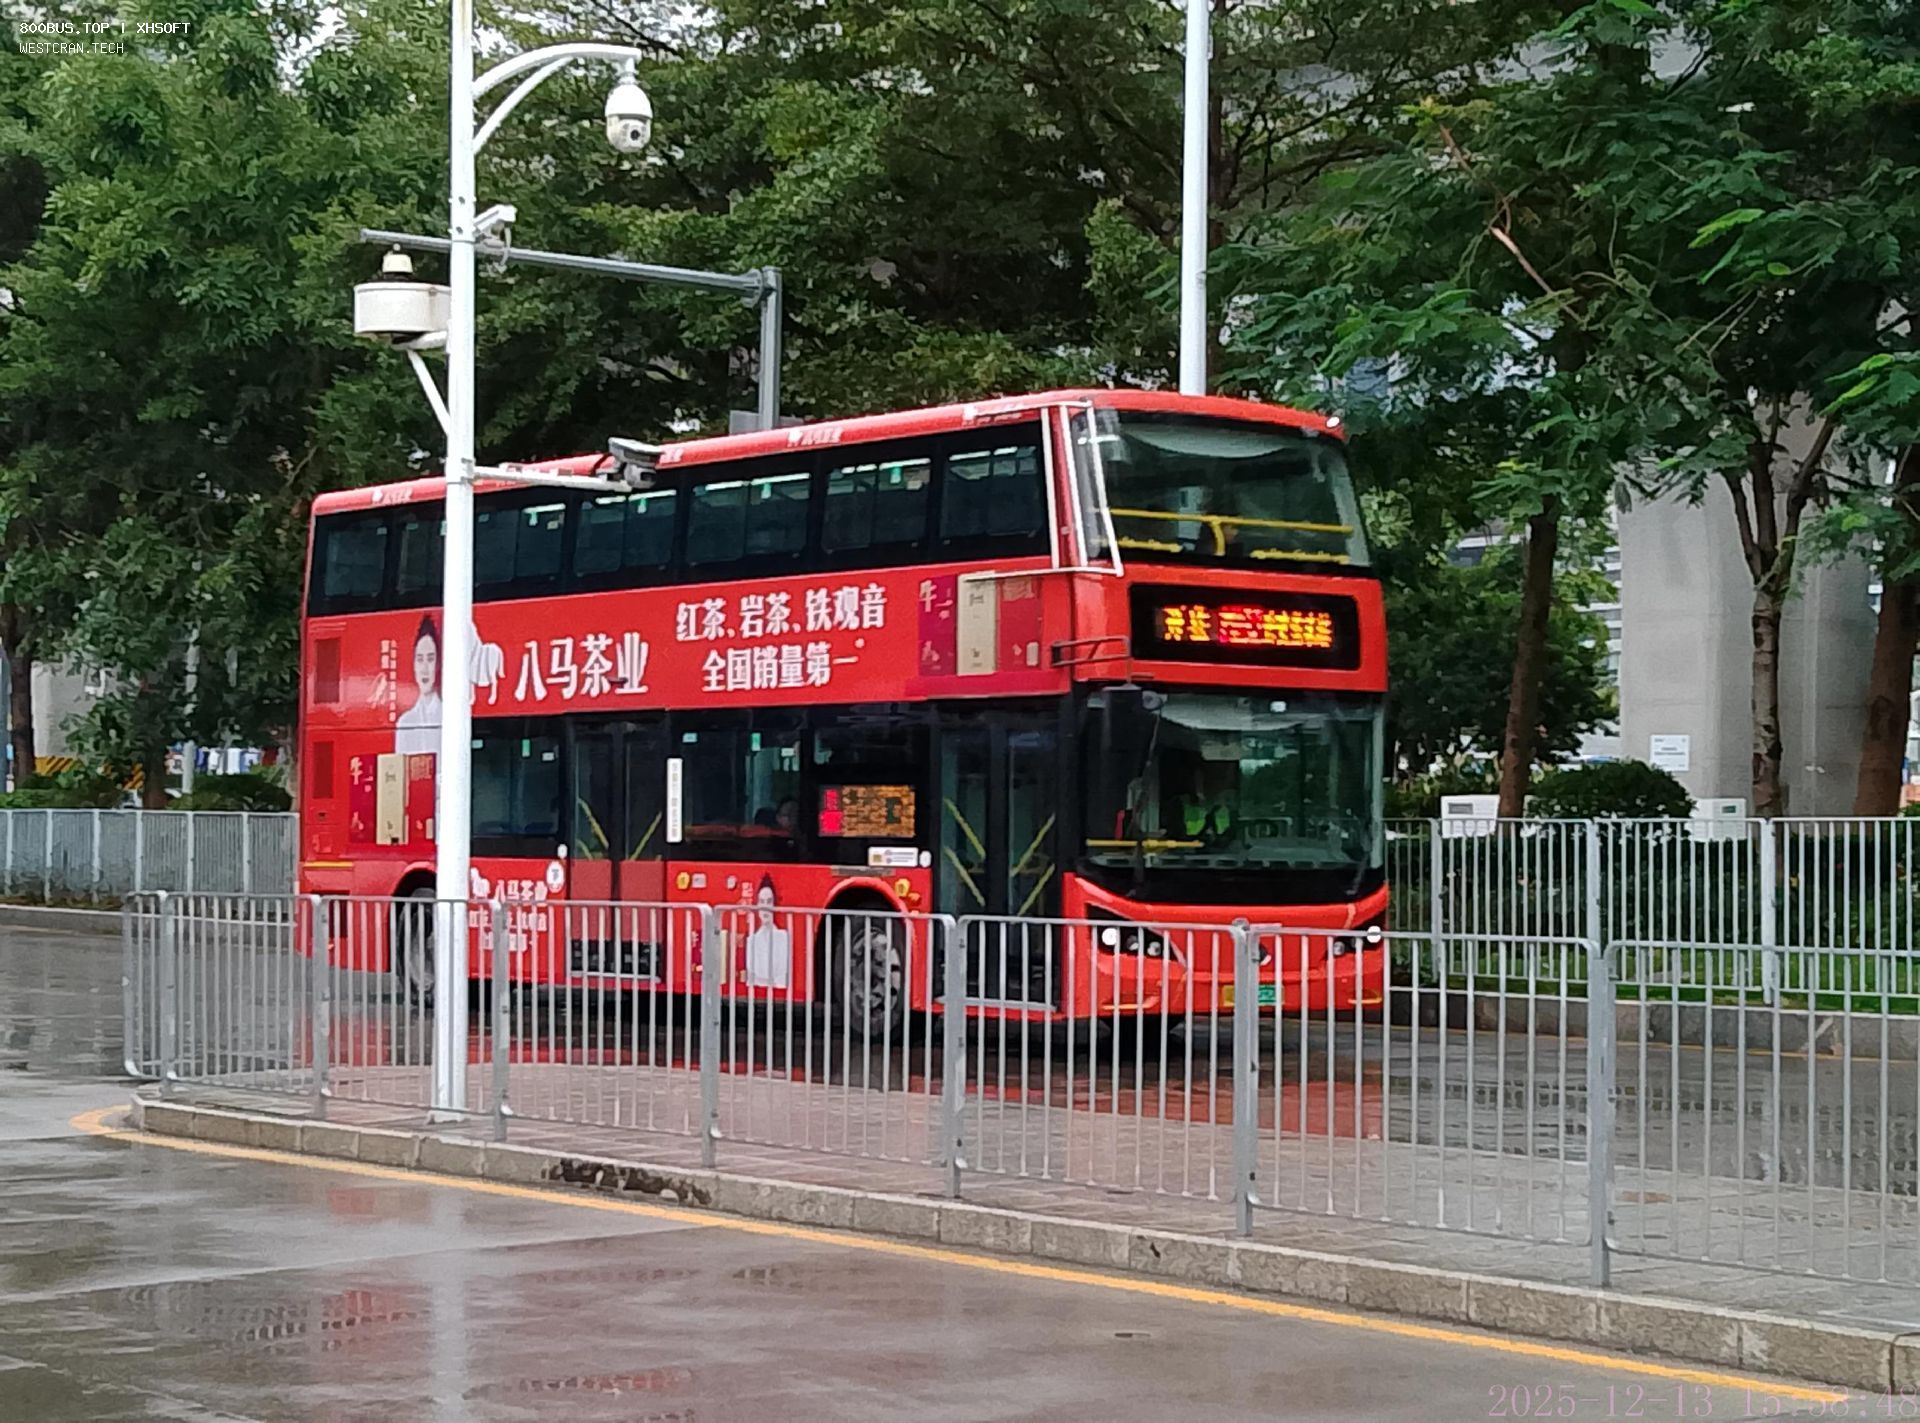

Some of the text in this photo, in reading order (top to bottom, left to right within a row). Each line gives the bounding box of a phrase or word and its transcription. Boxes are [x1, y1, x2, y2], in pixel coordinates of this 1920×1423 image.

[676, 582, 887, 642] 红茶、岩茶、铁观音
[514, 631, 649, 702] 八马茶业
